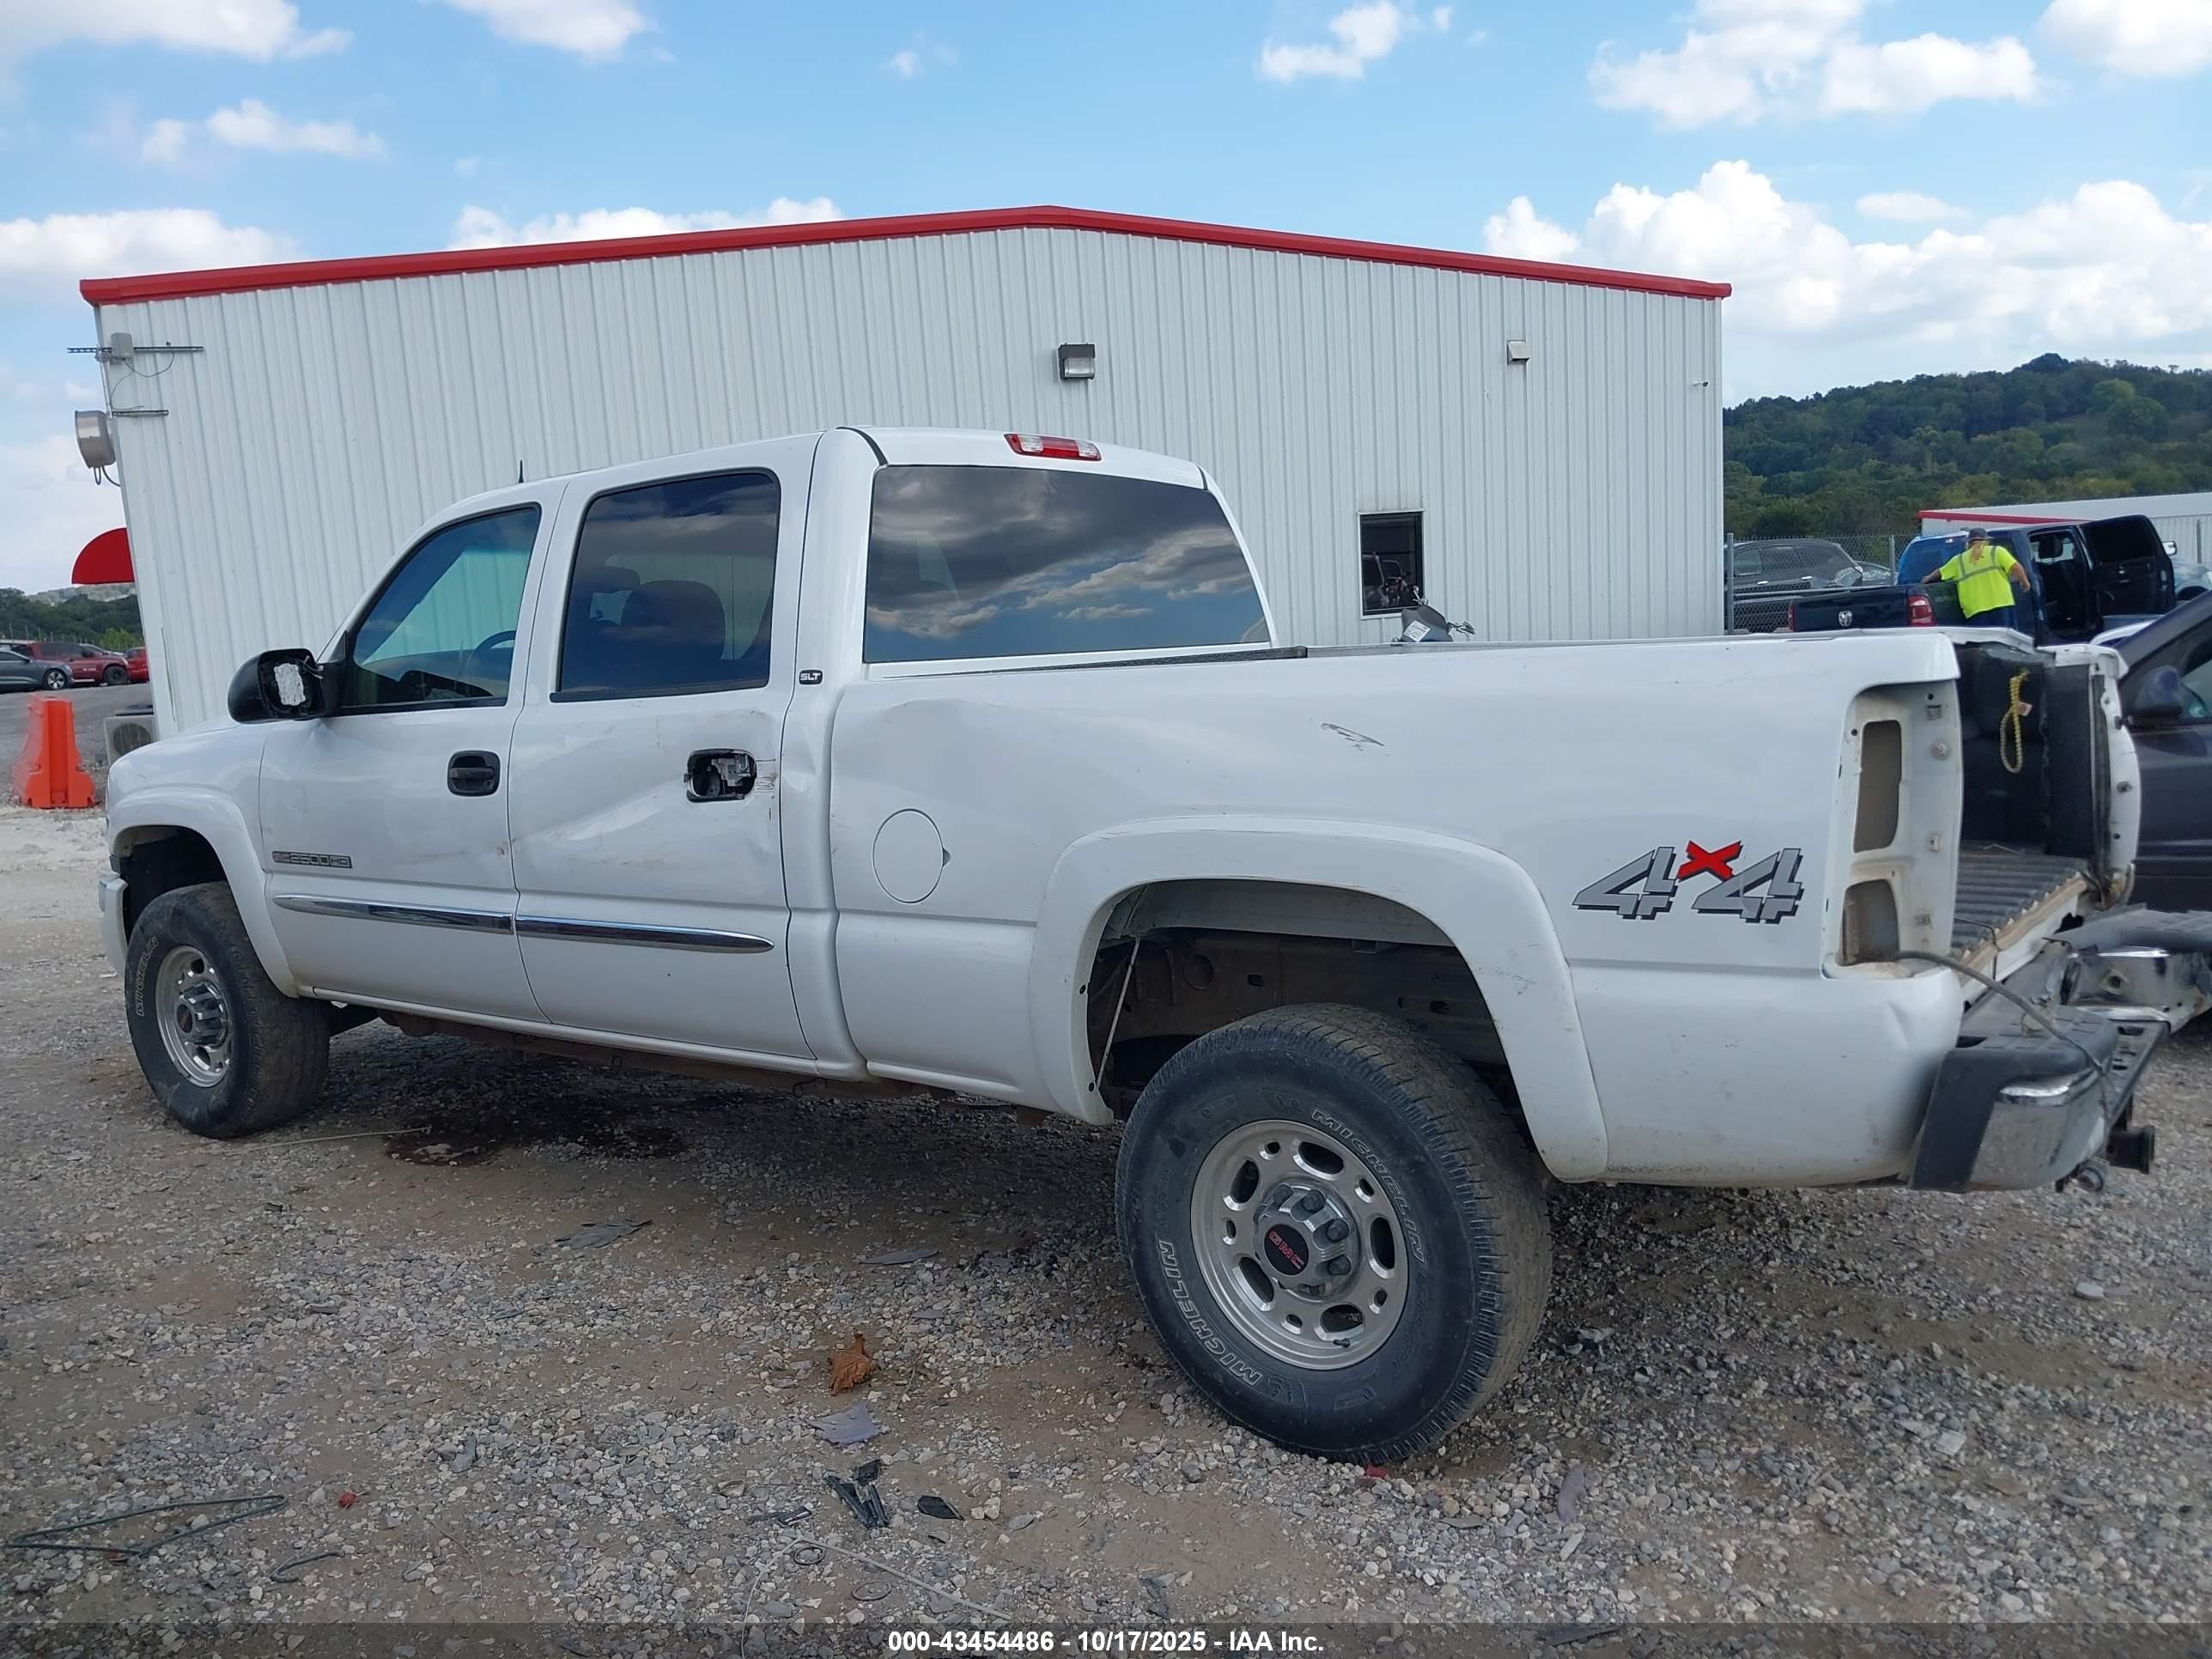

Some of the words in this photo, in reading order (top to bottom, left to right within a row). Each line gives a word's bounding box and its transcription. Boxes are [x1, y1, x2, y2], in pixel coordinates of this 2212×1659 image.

[800, 672, 821, 681] SLT
[1311, 1109, 1426, 1263] MICHELIN
[1268, 1231, 1305, 1270] GMC
[1158, 1239, 1263, 1386] MICHELIN
